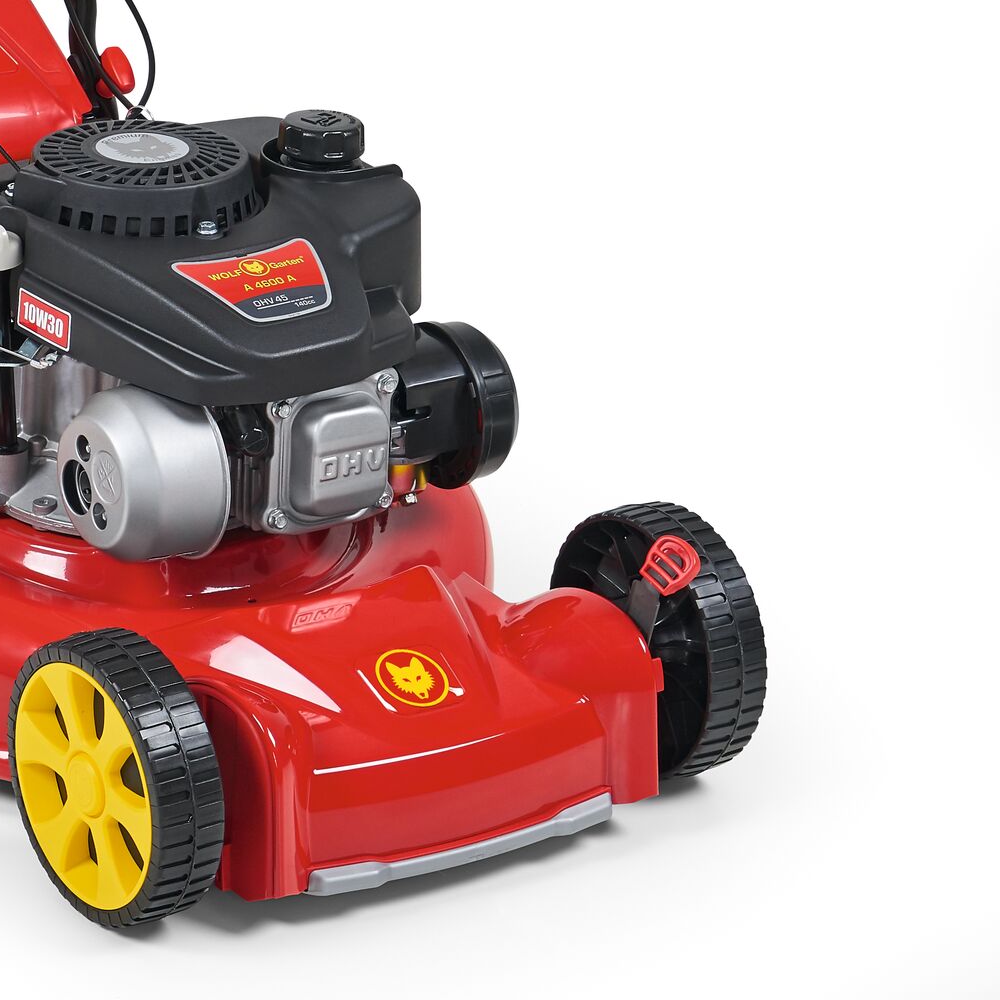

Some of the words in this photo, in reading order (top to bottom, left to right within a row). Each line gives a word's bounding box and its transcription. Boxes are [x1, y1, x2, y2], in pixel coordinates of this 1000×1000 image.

[208, 269, 242, 281] WOLF
[243, 283, 254, 292] A
[255, 276, 285, 289] 4600
[286, 274, 297, 283] A
[253, 296, 275, 307] OHV
[275, 294, 289, 302] 45
[294, 299, 316, 308] 140cc
[23, 301, 64, 338] 10W30
[319, 447, 386, 483] OHV
